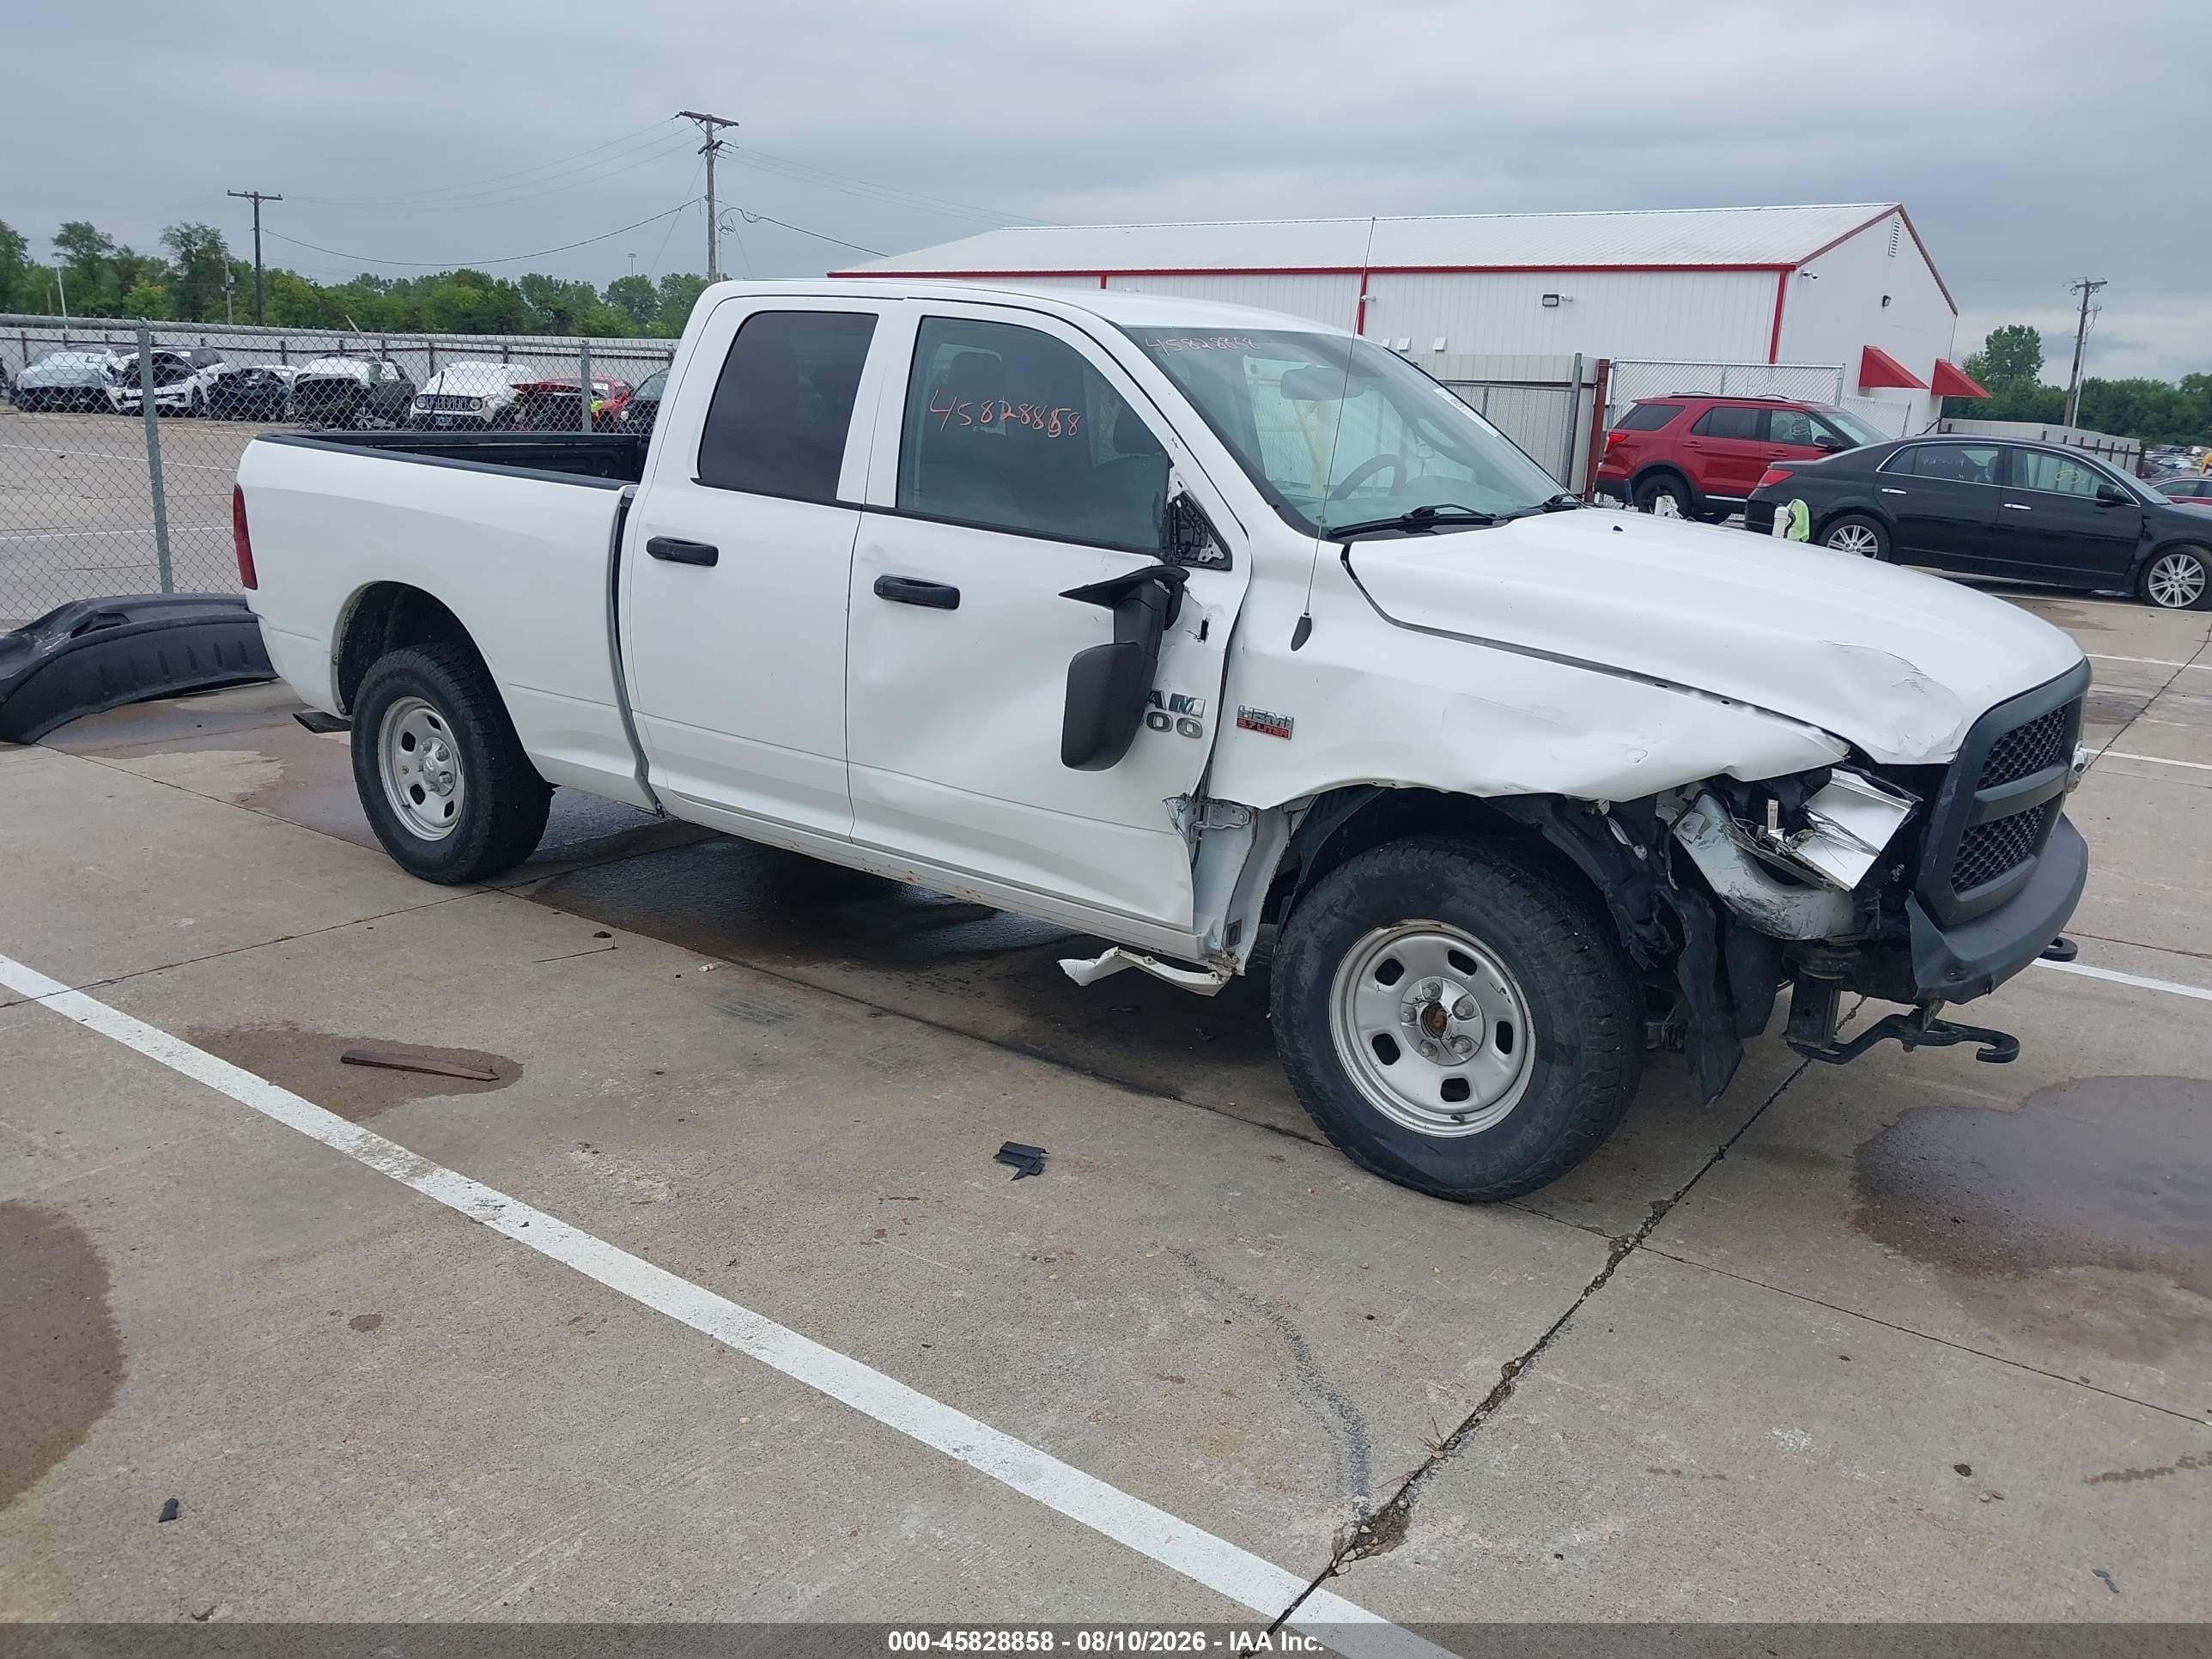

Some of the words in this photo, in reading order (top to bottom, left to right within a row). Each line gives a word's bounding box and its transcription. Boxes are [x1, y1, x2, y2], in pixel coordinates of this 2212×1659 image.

[1146, 690, 1206, 718] AM
[1140, 711, 1203, 739] 00
[1237, 705, 1294, 730] HEMI
[1256, 723, 1289, 738] LITER
